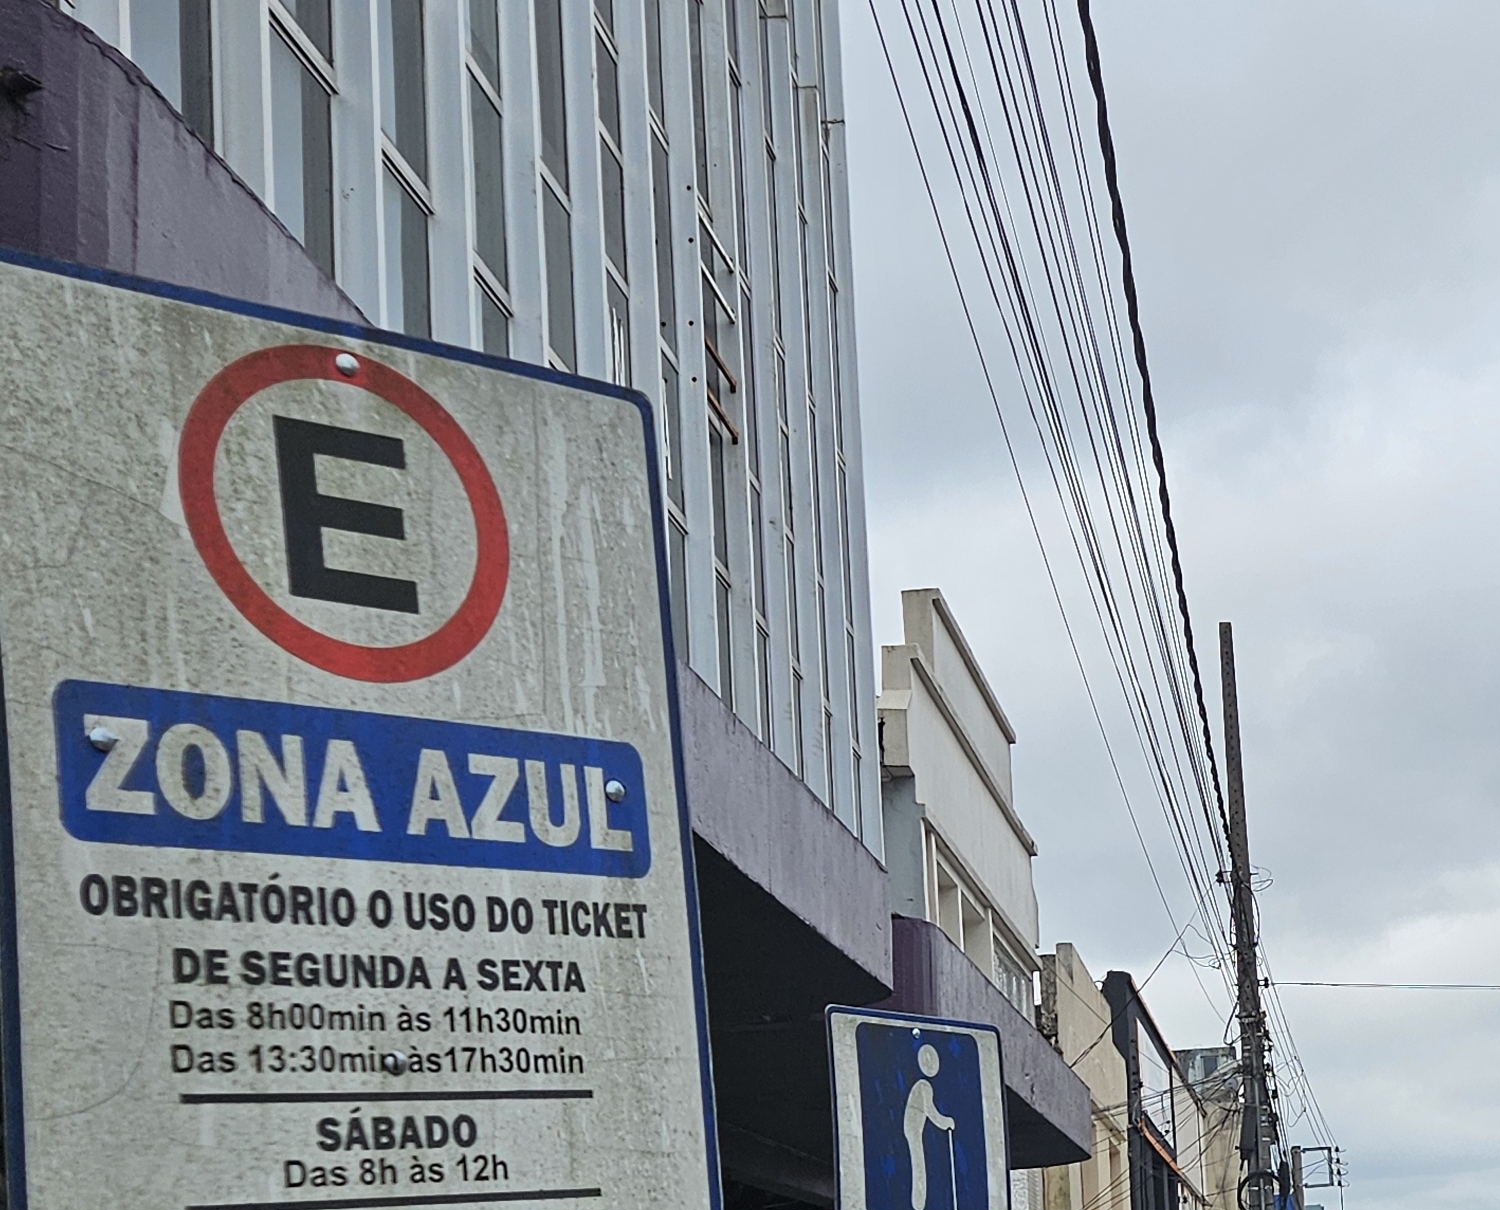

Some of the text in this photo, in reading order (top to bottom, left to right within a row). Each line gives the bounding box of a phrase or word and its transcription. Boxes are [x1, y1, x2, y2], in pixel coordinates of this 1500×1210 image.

[272, 415, 419, 614] E
[84, 714, 634, 851] ZONA AZUL
[80, 873, 647, 939] OBRIGATÓRIO O USO DO TICKET
[172, 948, 586, 994] DE SEGUNDA A SEXTA
[169, 1001, 581, 1035] Das 8h00min às 11h30min
[171, 1045, 236, 1074] Das
[250, 1046, 402, 1075] 13:30min
[316, 1107, 478, 1151] SÁBADO
[284, 1153, 509, 1188] Das 8h às 12h
